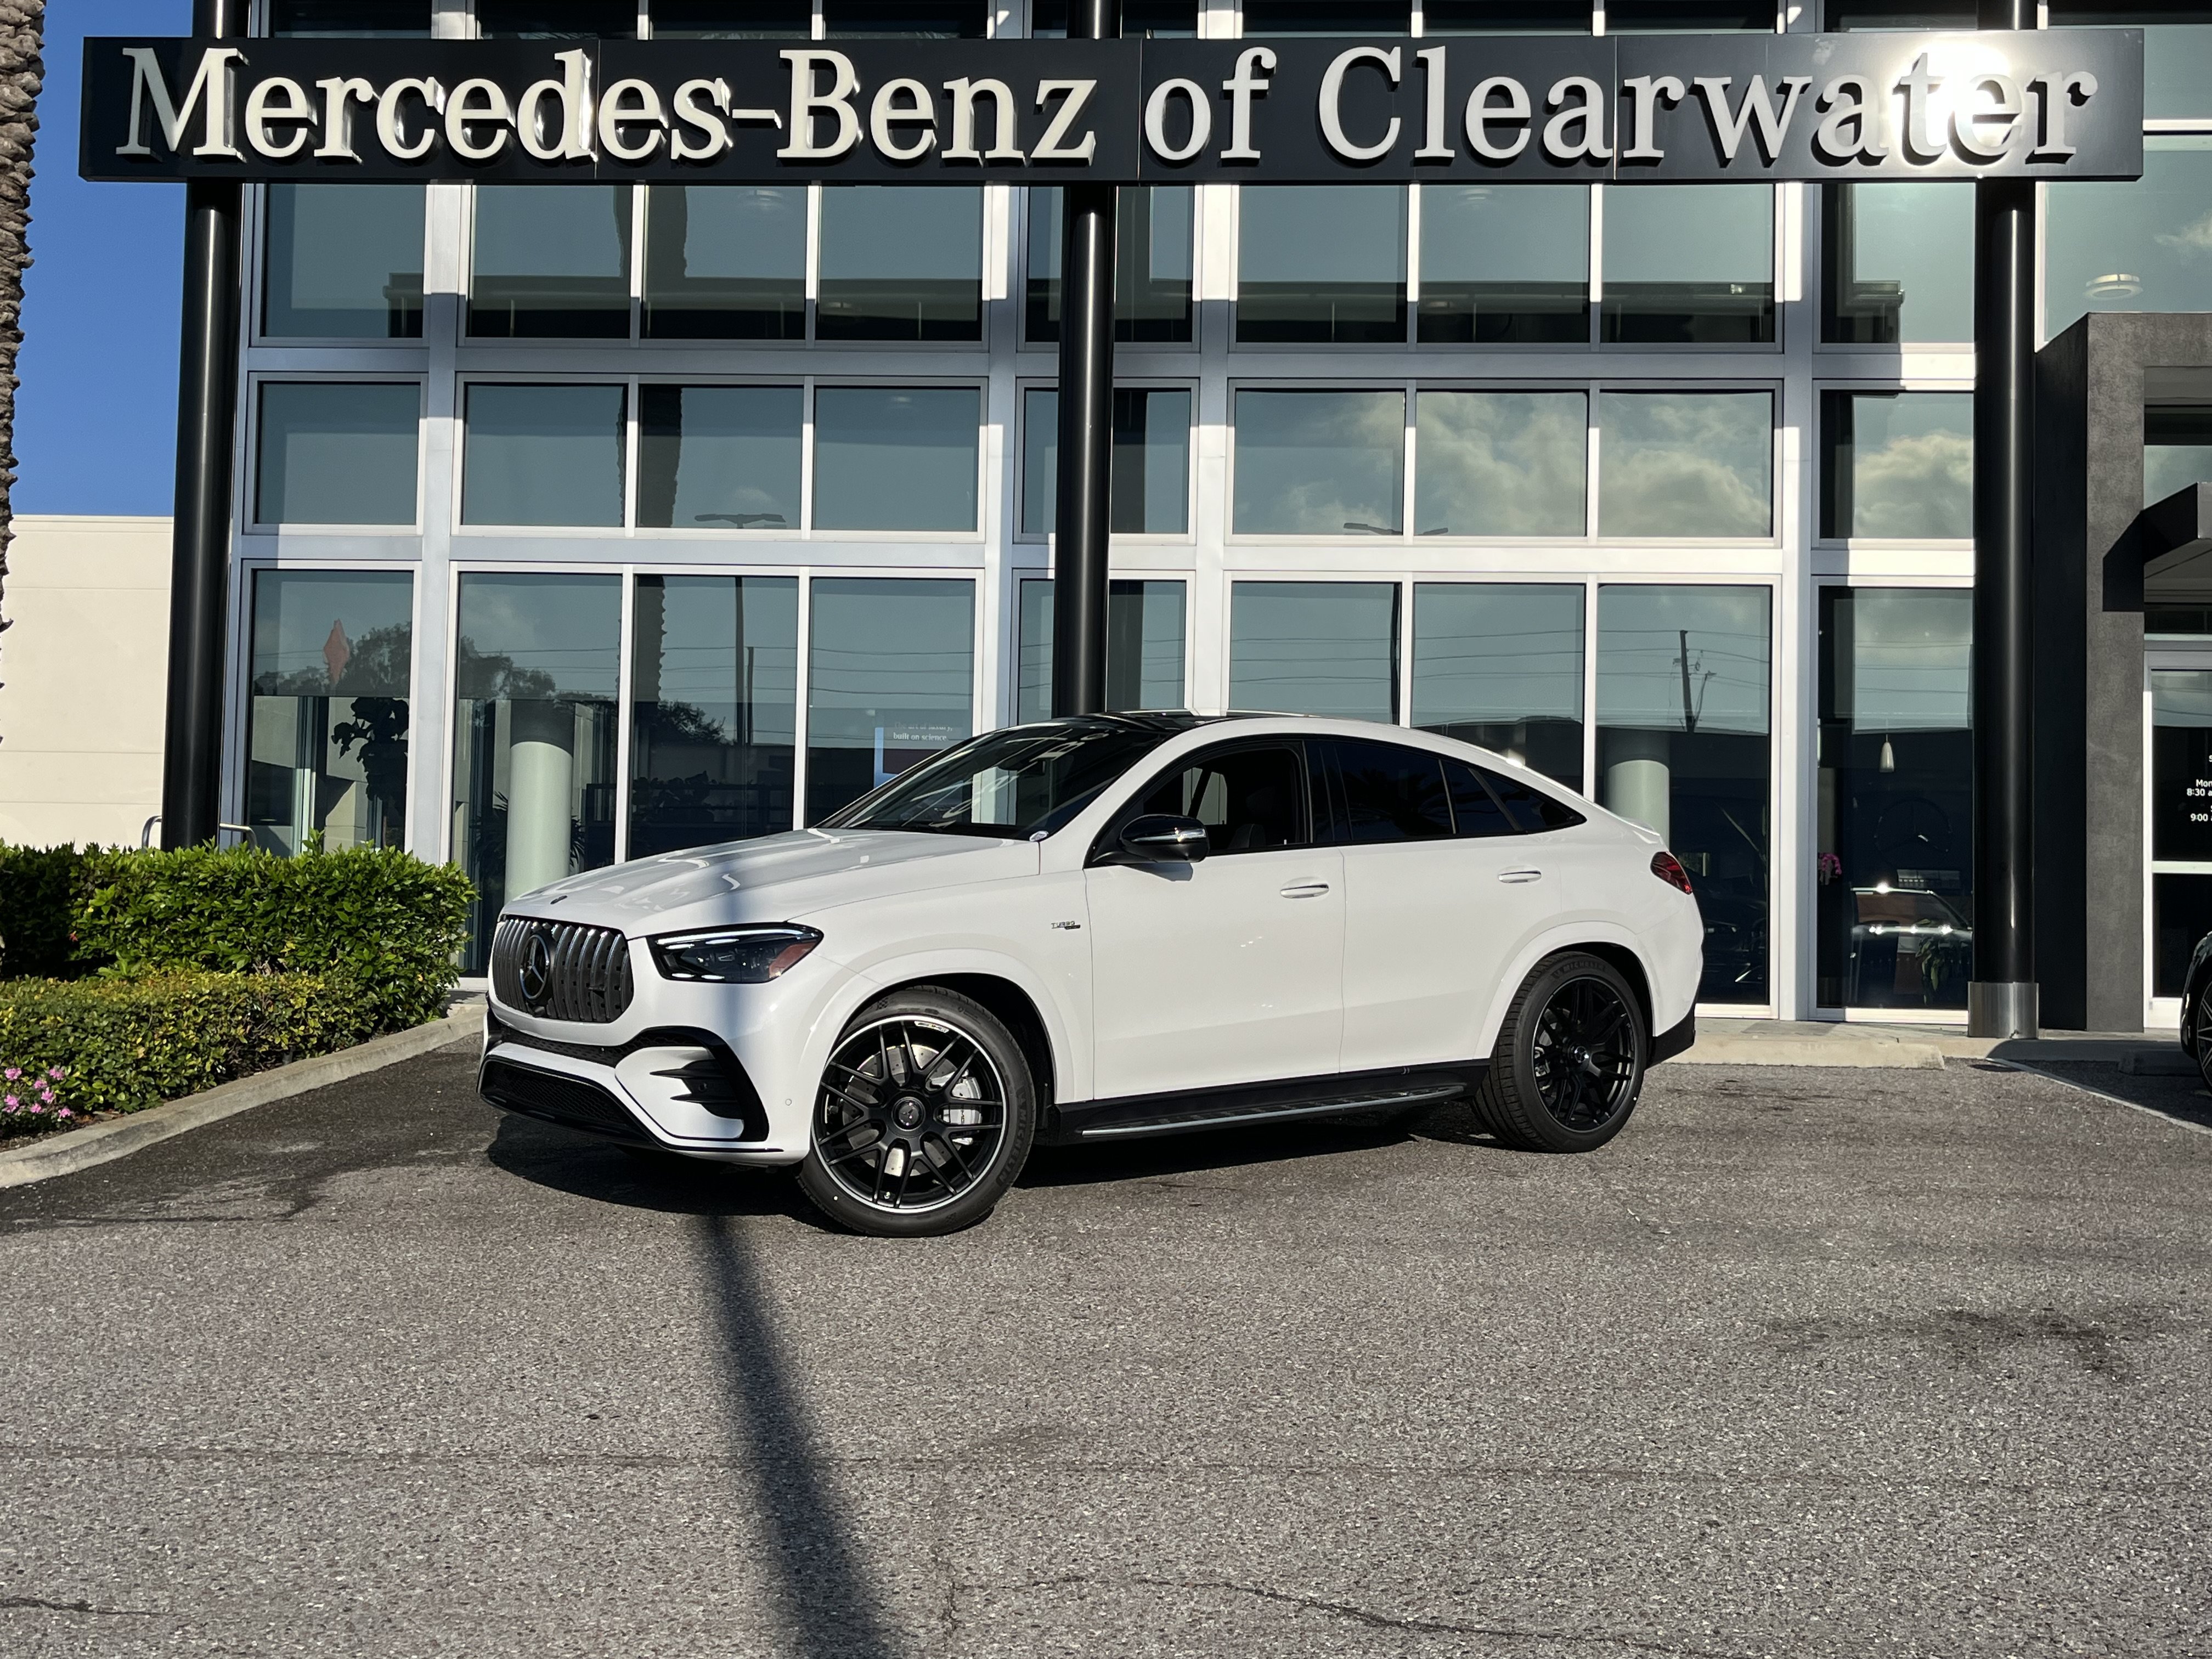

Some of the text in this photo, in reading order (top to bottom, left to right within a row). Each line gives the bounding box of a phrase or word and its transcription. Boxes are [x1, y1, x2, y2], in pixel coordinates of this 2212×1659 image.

[115, 46, 2098, 165] Mercedes-Benz of Clearwater
[893, 731, 909, 740] built
[922, 733, 947, 741] science
[2186, 788, 2205, 796] 8:30
[2190, 813, 2208, 821] 9:00
